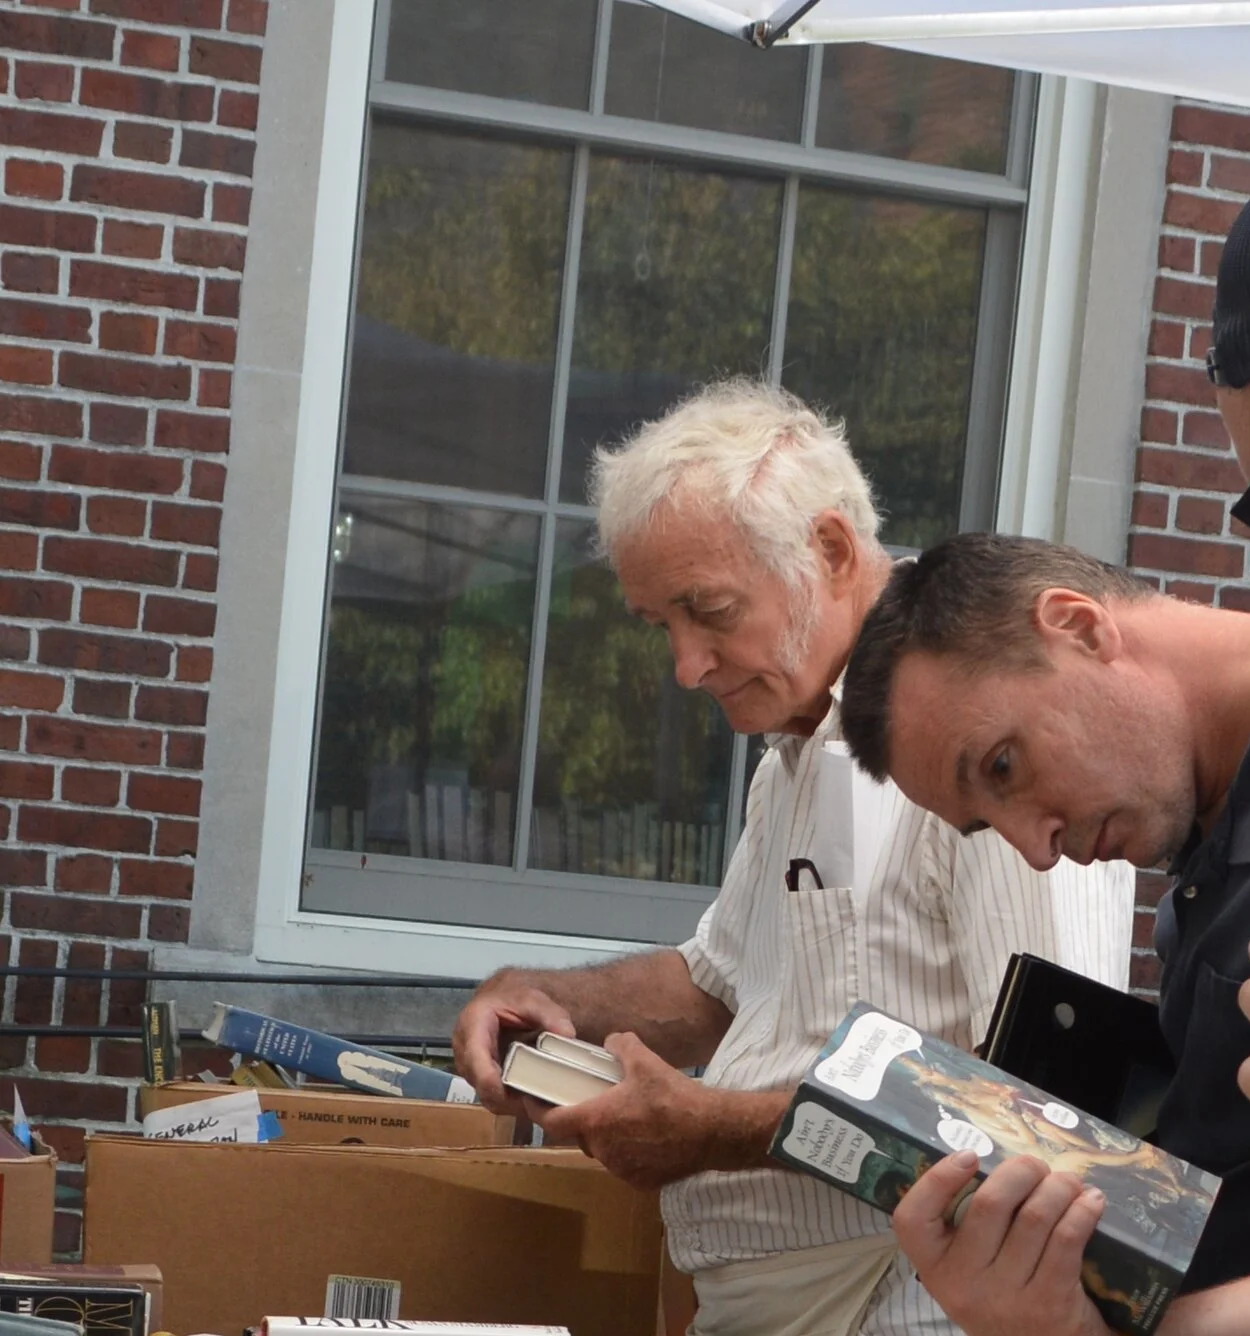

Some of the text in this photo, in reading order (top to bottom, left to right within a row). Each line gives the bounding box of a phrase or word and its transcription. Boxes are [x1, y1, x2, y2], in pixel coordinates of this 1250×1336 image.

[298, 1111, 411, 1128] HANDLE WITH CARE
